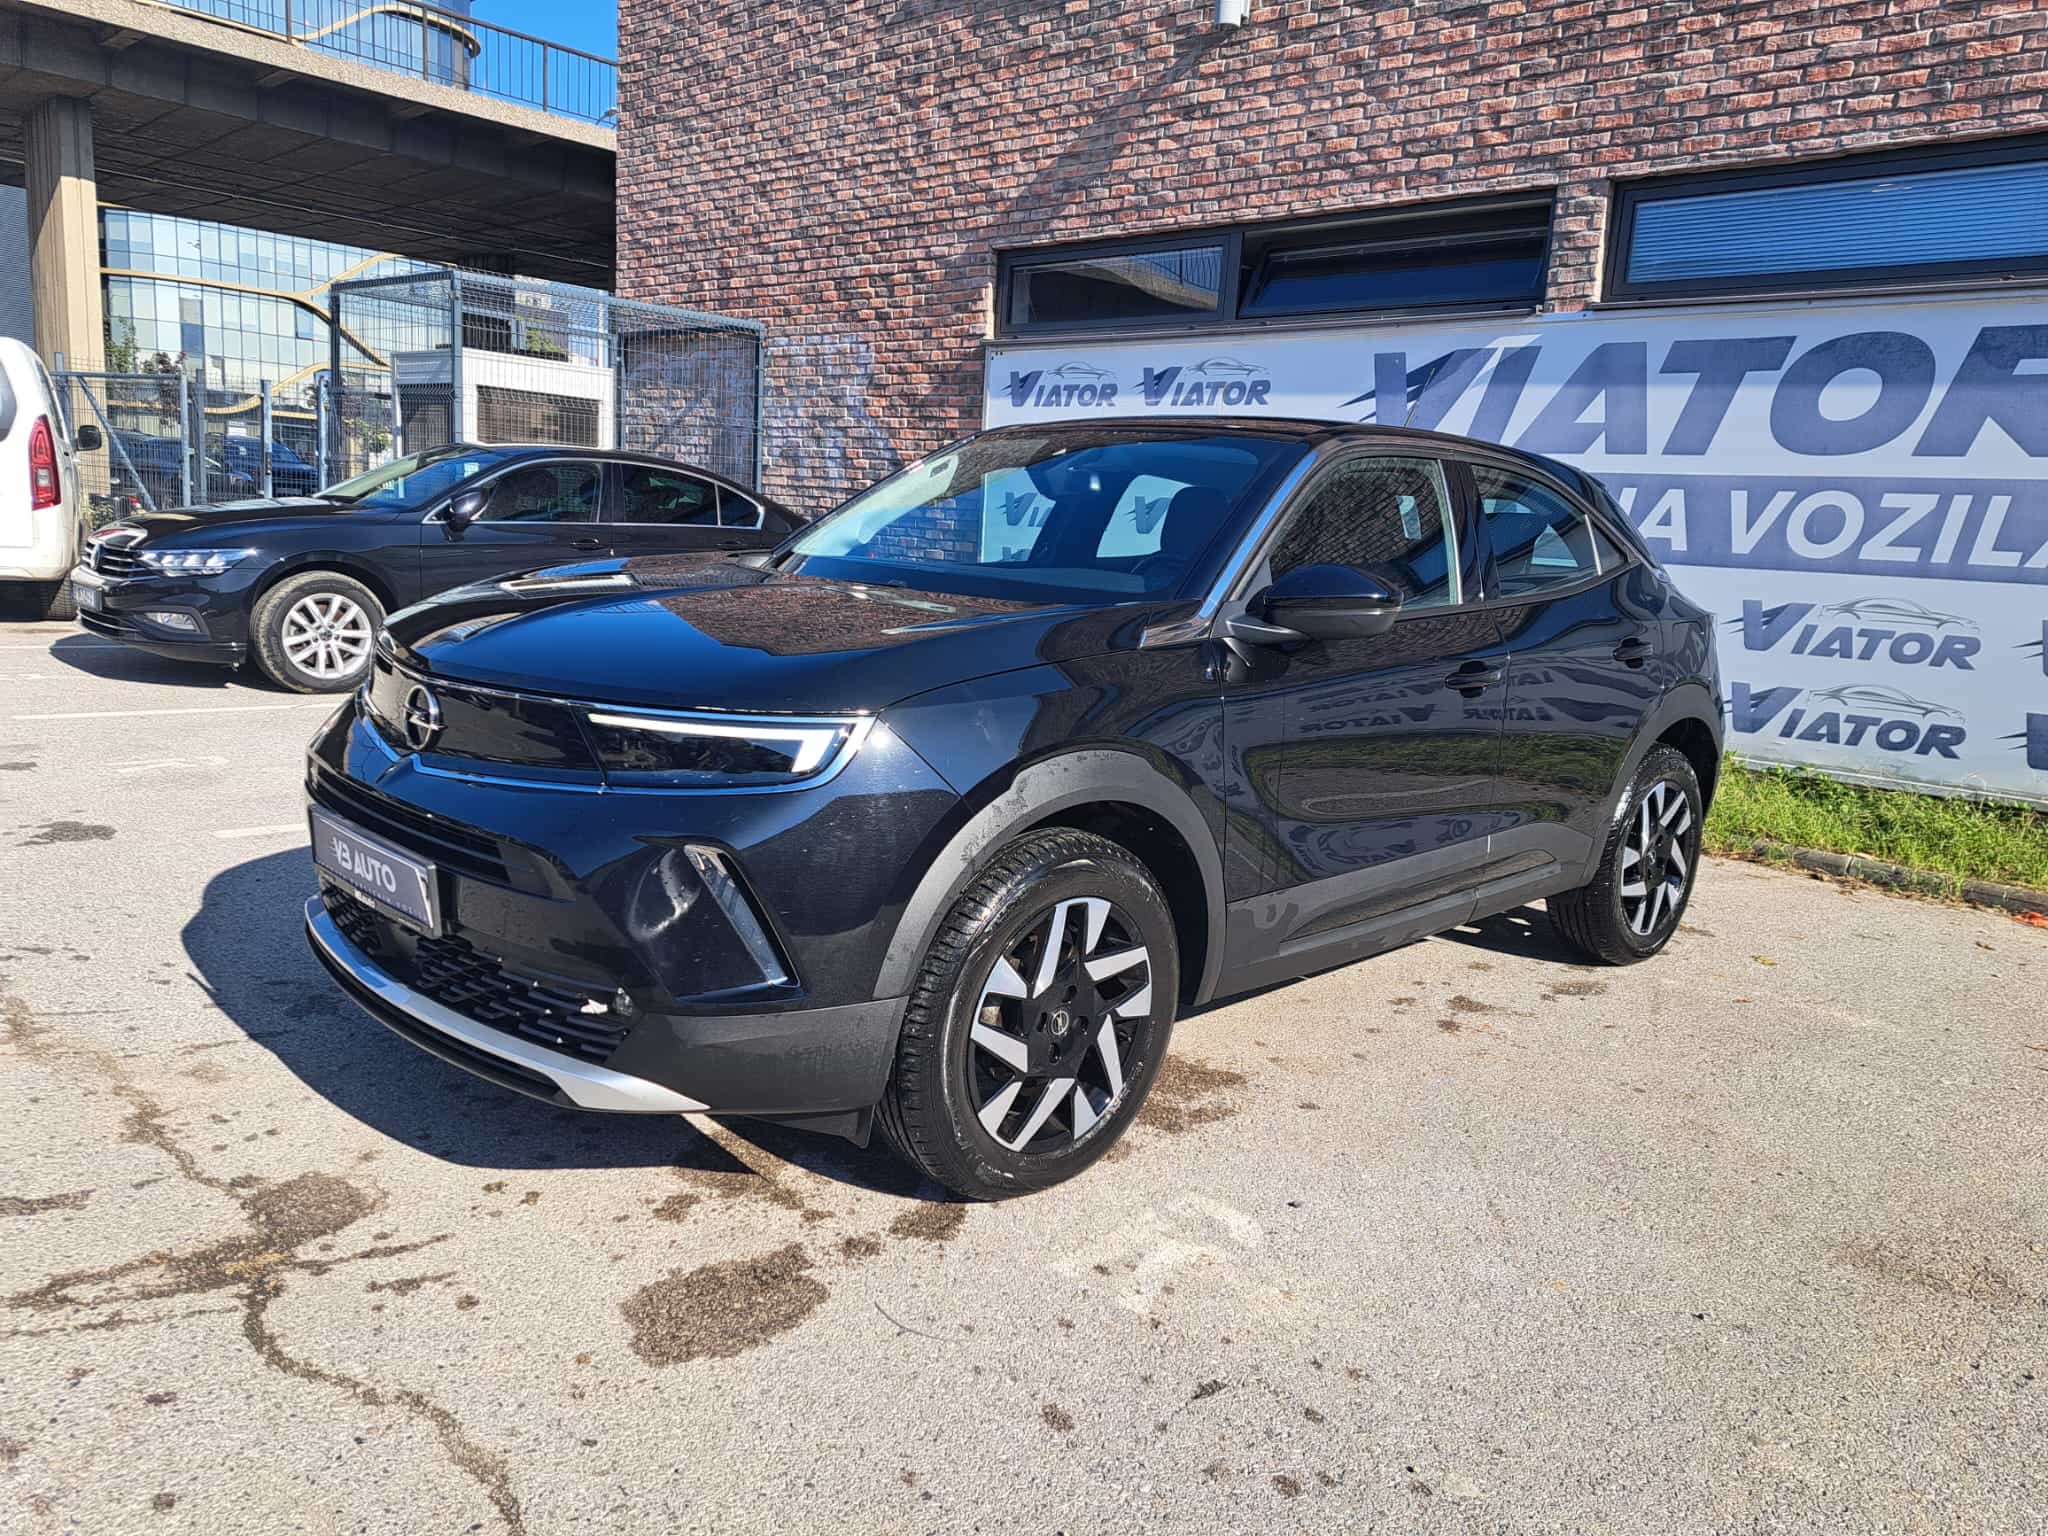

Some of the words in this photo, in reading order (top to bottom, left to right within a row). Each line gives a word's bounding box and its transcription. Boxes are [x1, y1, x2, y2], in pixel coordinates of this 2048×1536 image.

[1009, 370, 1119, 408] VIATOR
[1142, 366, 1272, 407] VIATOR
[1742, 600, 1982, 671] VIATOR
[1731, 682, 1967, 760] VIATOR
[354, 852, 397, 893] AUTO
